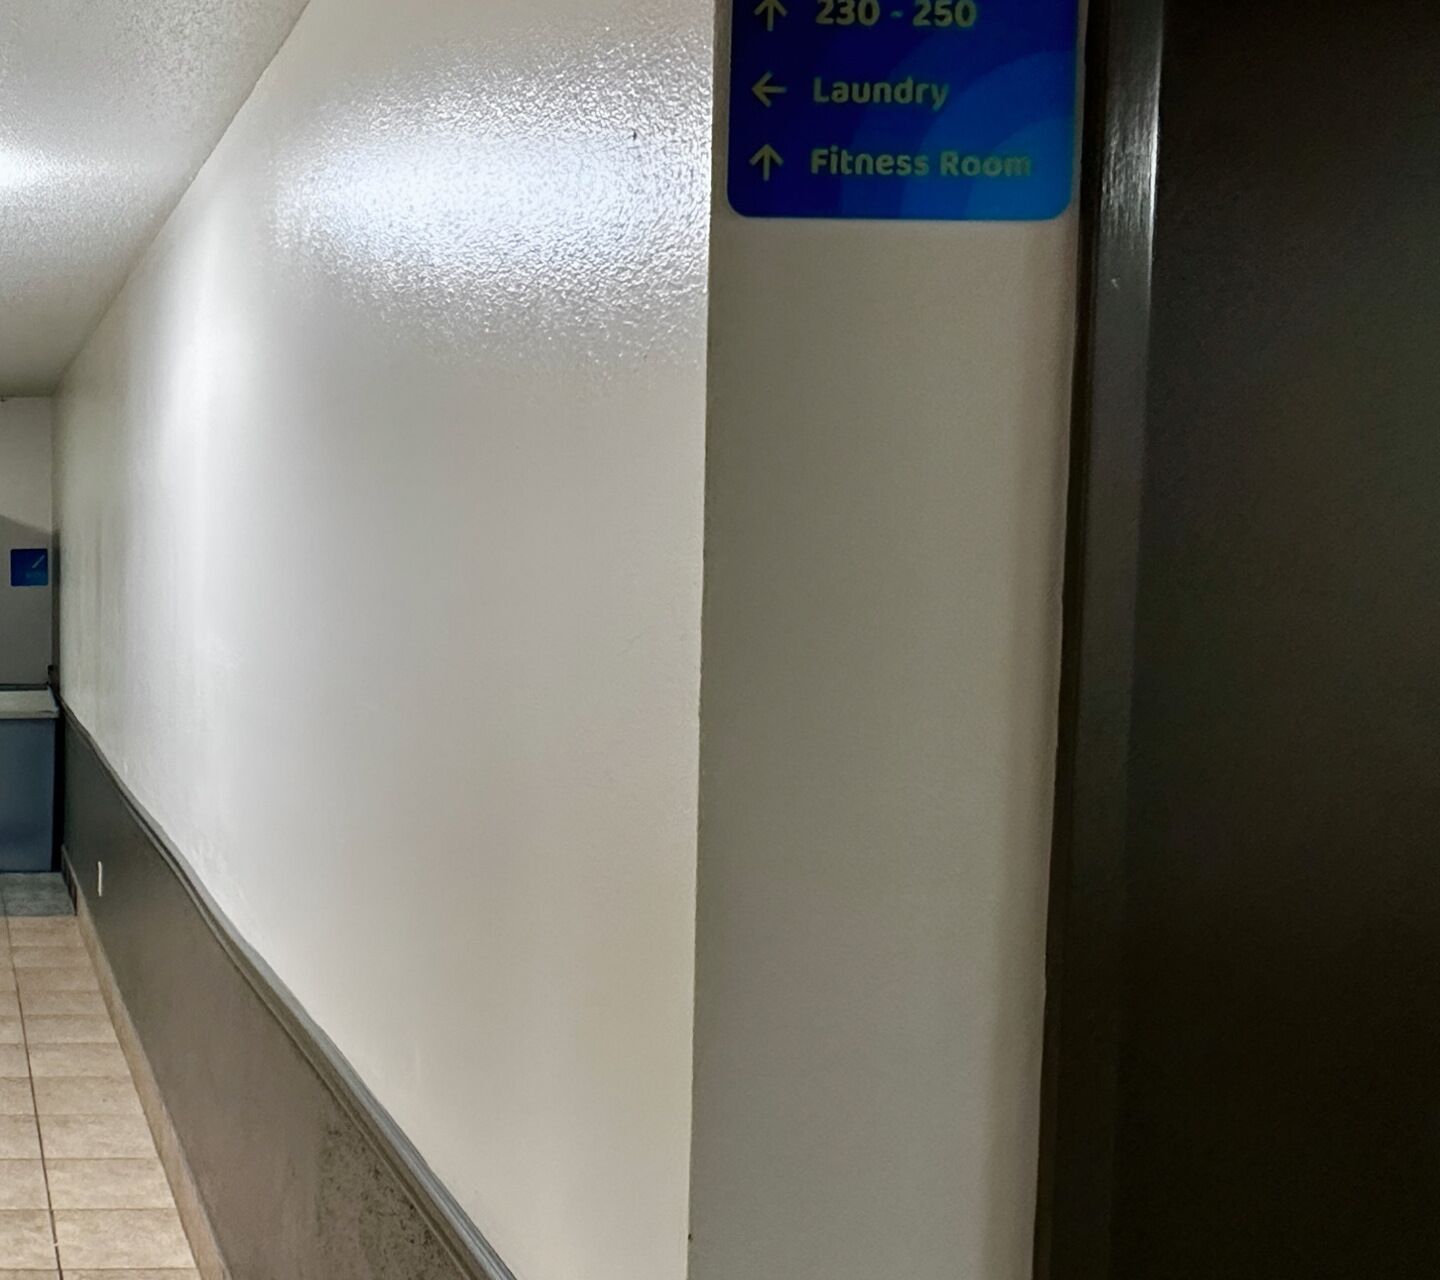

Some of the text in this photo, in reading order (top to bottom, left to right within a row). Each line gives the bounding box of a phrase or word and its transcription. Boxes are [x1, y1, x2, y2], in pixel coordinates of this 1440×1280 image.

[812, 76, 949, 111] Laundry
[810, 146, 1032, 177] Fitness Room
